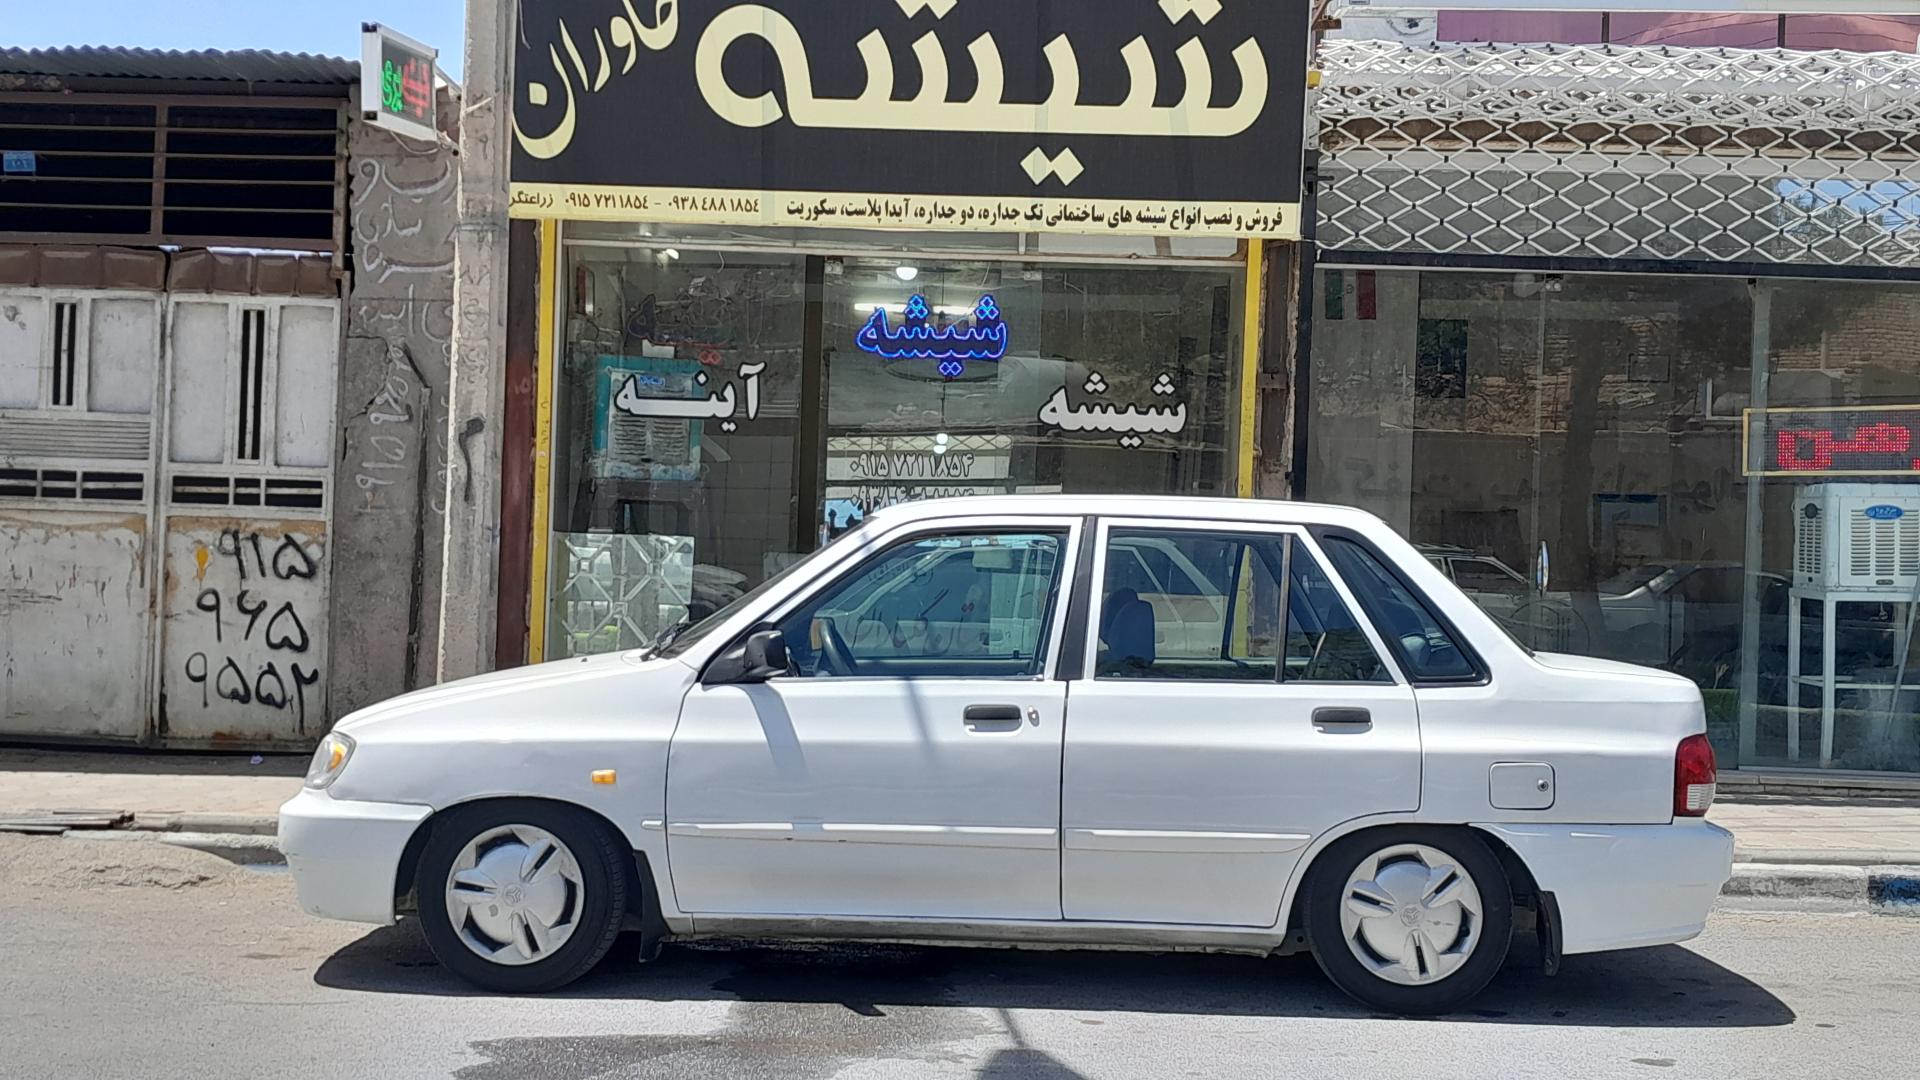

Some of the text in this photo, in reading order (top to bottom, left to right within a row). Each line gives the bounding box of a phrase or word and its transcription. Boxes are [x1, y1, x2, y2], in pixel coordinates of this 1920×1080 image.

[695, 0, 1269, 187] شیشه
[786, 198, 837, 221] سکوریت
[885, 198, 911, 223] آیدا
[959, 206, 975, 225] دو
[1023, 203, 1044, 221] تک
[1045, 204, 1105, 227] ساختمانی
[1107, 206, 1132, 228] های
[1135, 206, 1167, 228] شیشه
[1169, 206, 1201, 230] انواع
[1203, 207, 1233, 230] نصب
[1245, 207, 1283, 232] فروش
[1235, 214, 1242, 231] و
[856, 293, 1008, 378] شیشه
[614, 361, 768, 432] آینه
[1037, 371, 1188, 449] شیشه
[1776, 422, 1920, 471] هن
[849, 452, 975, 478] ۰۹۱۵ ۷۲۱ ۱۸۵۴
[218, 528, 317, 580] ۹۱۵
[196, 587, 309, 653] ۹۶۵
[185, 651, 319, 736] ۹۵۵۲
